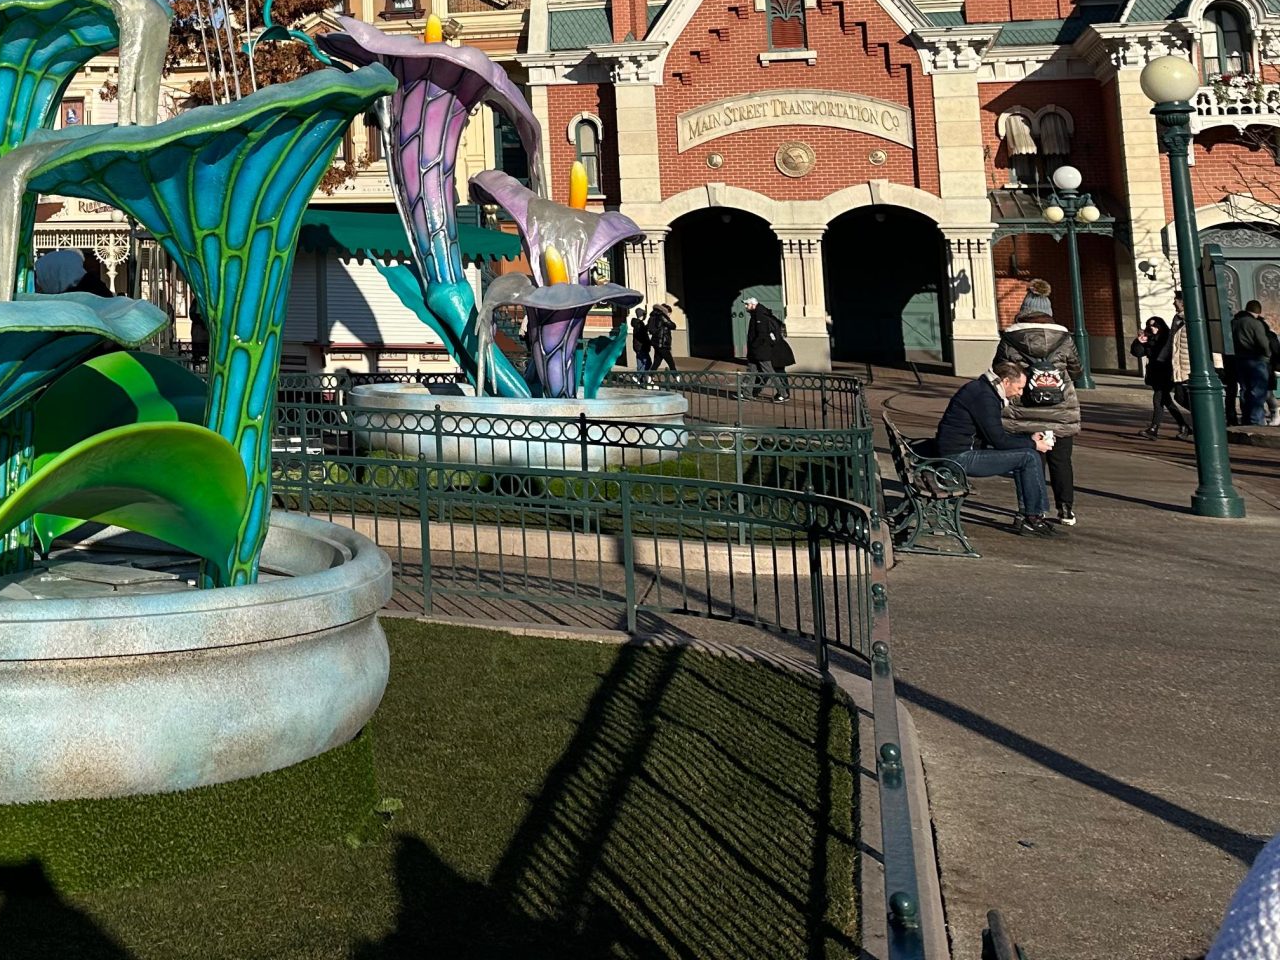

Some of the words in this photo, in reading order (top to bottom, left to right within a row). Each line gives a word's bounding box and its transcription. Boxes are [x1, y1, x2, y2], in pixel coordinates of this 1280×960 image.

[687, 112, 721, 141] MAIN
[723, 102, 769, 127] STREET
[770, 98, 879, 126] TRANSPORTATION
